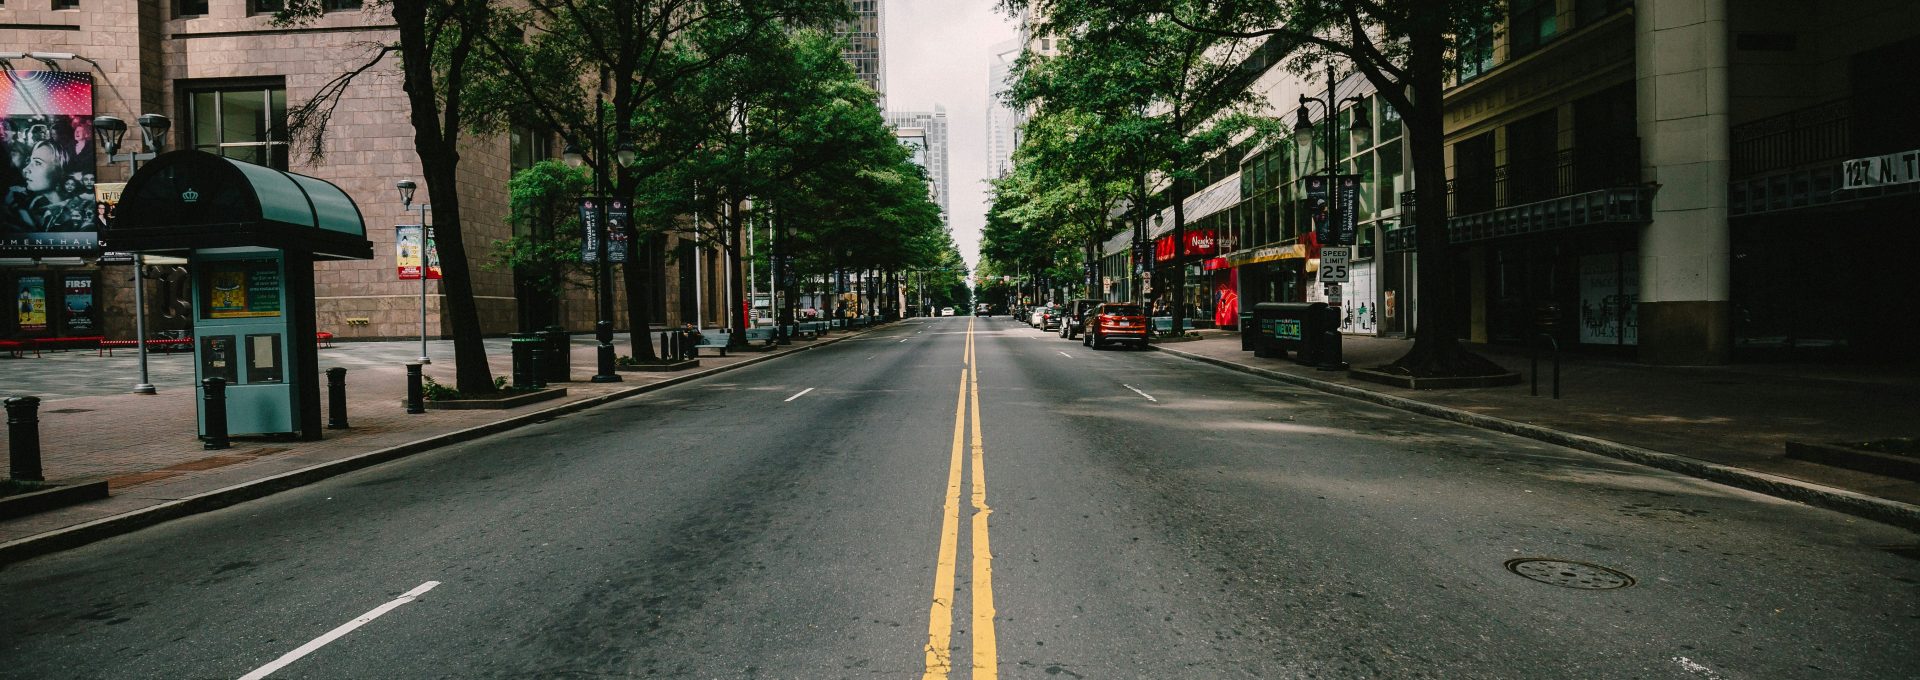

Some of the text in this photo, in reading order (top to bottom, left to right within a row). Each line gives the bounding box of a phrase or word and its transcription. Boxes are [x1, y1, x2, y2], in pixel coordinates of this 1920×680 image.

[1846, 153, 1920, 186] 127 N. T
[1322, 265, 1347, 279] 25
[65, 280, 92, 288] FIRST
[1276, 323, 1300, 337] WELCOME
